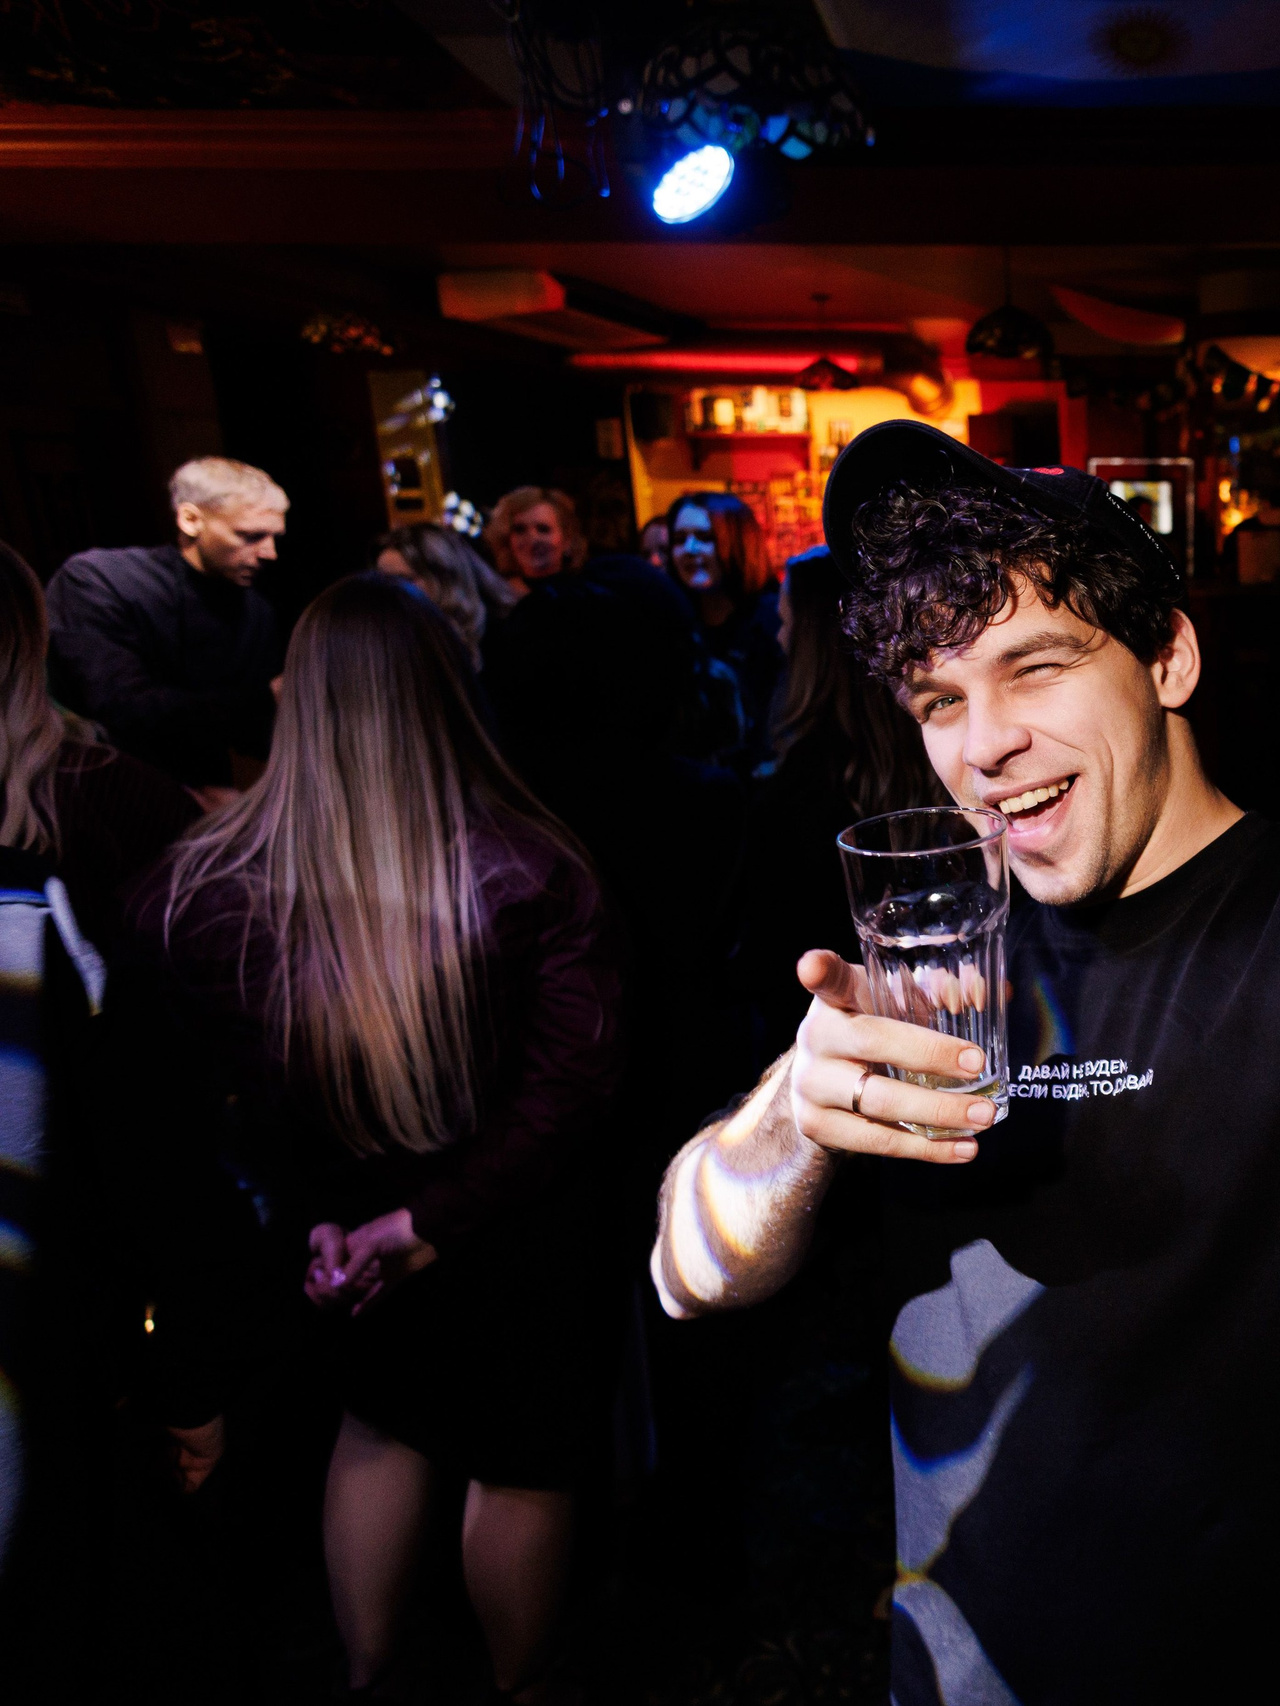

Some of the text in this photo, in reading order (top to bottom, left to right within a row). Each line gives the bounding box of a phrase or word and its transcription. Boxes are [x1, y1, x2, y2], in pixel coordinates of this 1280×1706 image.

[1018, 1062, 1070, 1082] ДАВАЙ
[1008, 1083, 1049, 1099] ЕСЛИ
[1089, 1080, 1113, 1096] ТО
